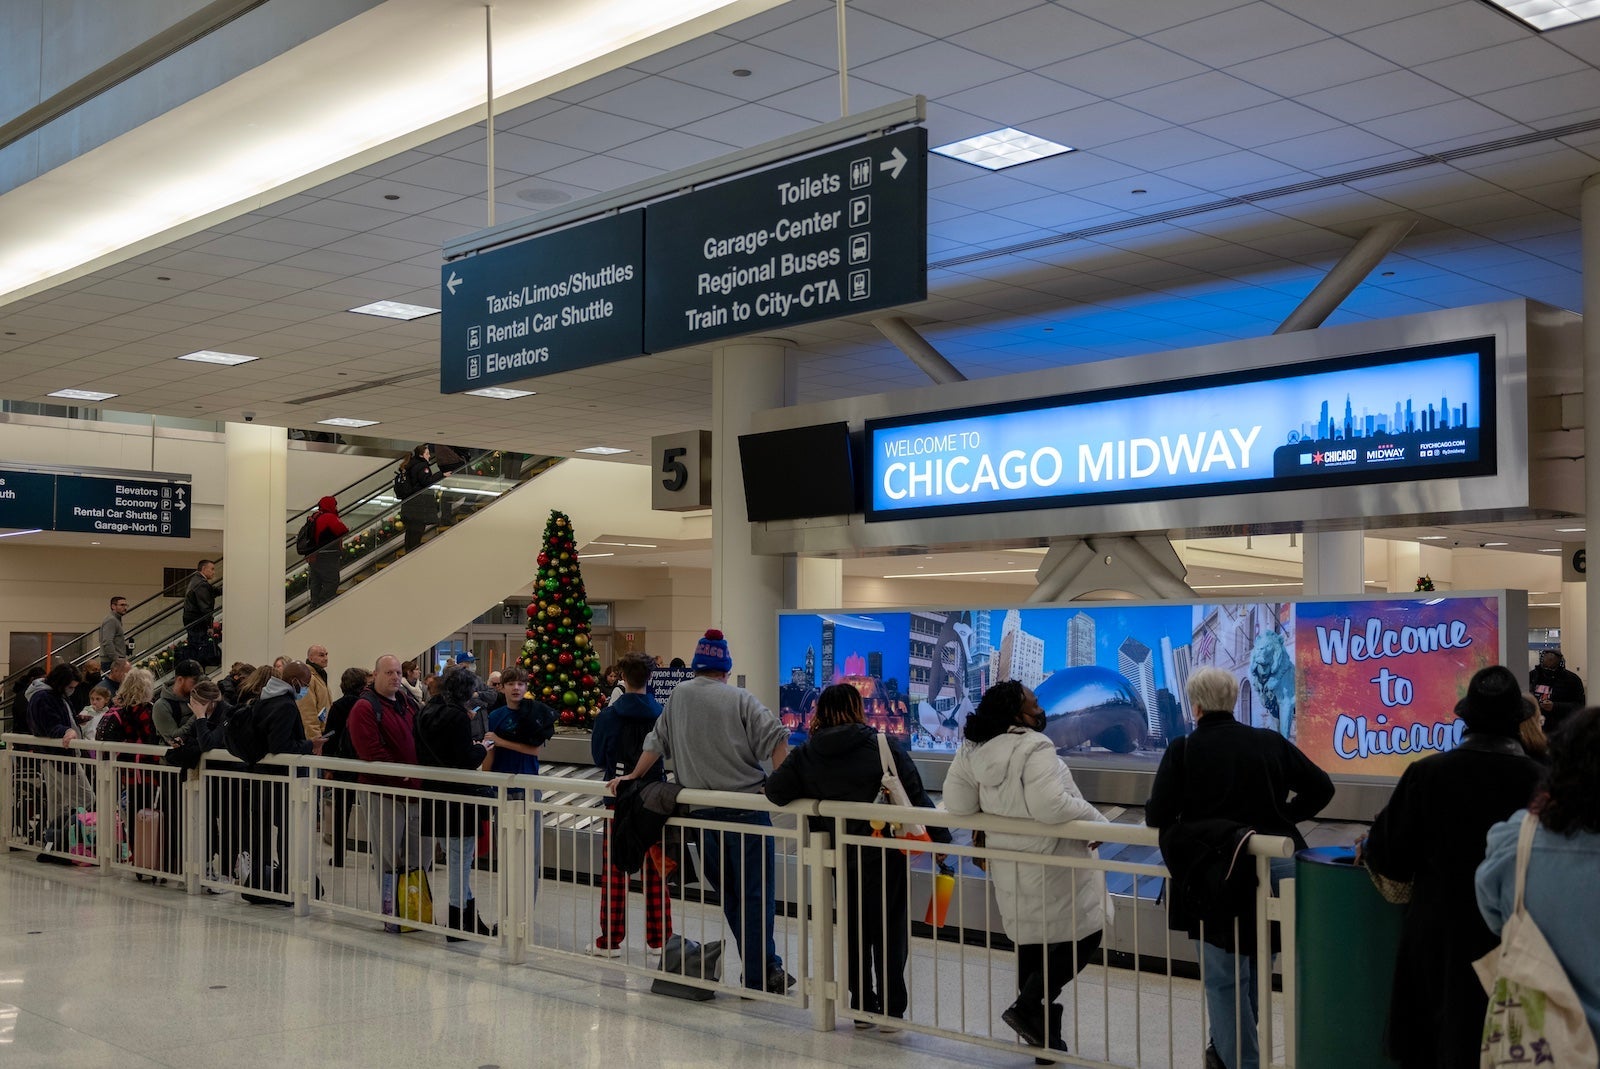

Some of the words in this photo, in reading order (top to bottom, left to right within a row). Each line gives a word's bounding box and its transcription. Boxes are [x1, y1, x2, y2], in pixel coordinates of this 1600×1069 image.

[777, 173, 840, 205] Toilets
[703, 210, 840, 259] Garage-Center
[698, 257, 776, 295] Regional
[780, 247, 840, 276] Buses
[486, 264, 633, 314] Taxis/Limos/Shuttles
[685, 305, 727, 331] Train
[731, 301, 750, 321] to
[755, 279, 840, 321] City-CTA
[486, 317, 529, 343] Rental
[532, 313, 558, 333] Car
[561, 299, 613, 327] Shuttle
[486, 347, 549, 373] Elevators
[884, 433, 957, 459] WELCOME
[959, 431, 980, 450] TO
[1324, 449, 1357, 462] CHICAGO
[1366, 447, 1405, 460] MIDWAY
[1420, 440, 1465, 449] FLYCHICAGO.COM
[662, 447, 687, 492] 5
[883, 446, 1063, 501] CHICAGO
[1078, 425, 1263, 484] MIDWAY
[115, 485, 158, 497] Elevators
[115, 498, 158, 510] Economy
[73, 507, 104, 518] Rental
[106, 509, 124, 519] Car
[125, 510, 158, 521] Shuttle
[94, 521, 157, 533] Garage-North
[1316, 617, 1473, 665] Welcome
[652, 680, 665, 688] you
[671, 669, 685, 677] who
[1369, 667, 1414, 707] to
